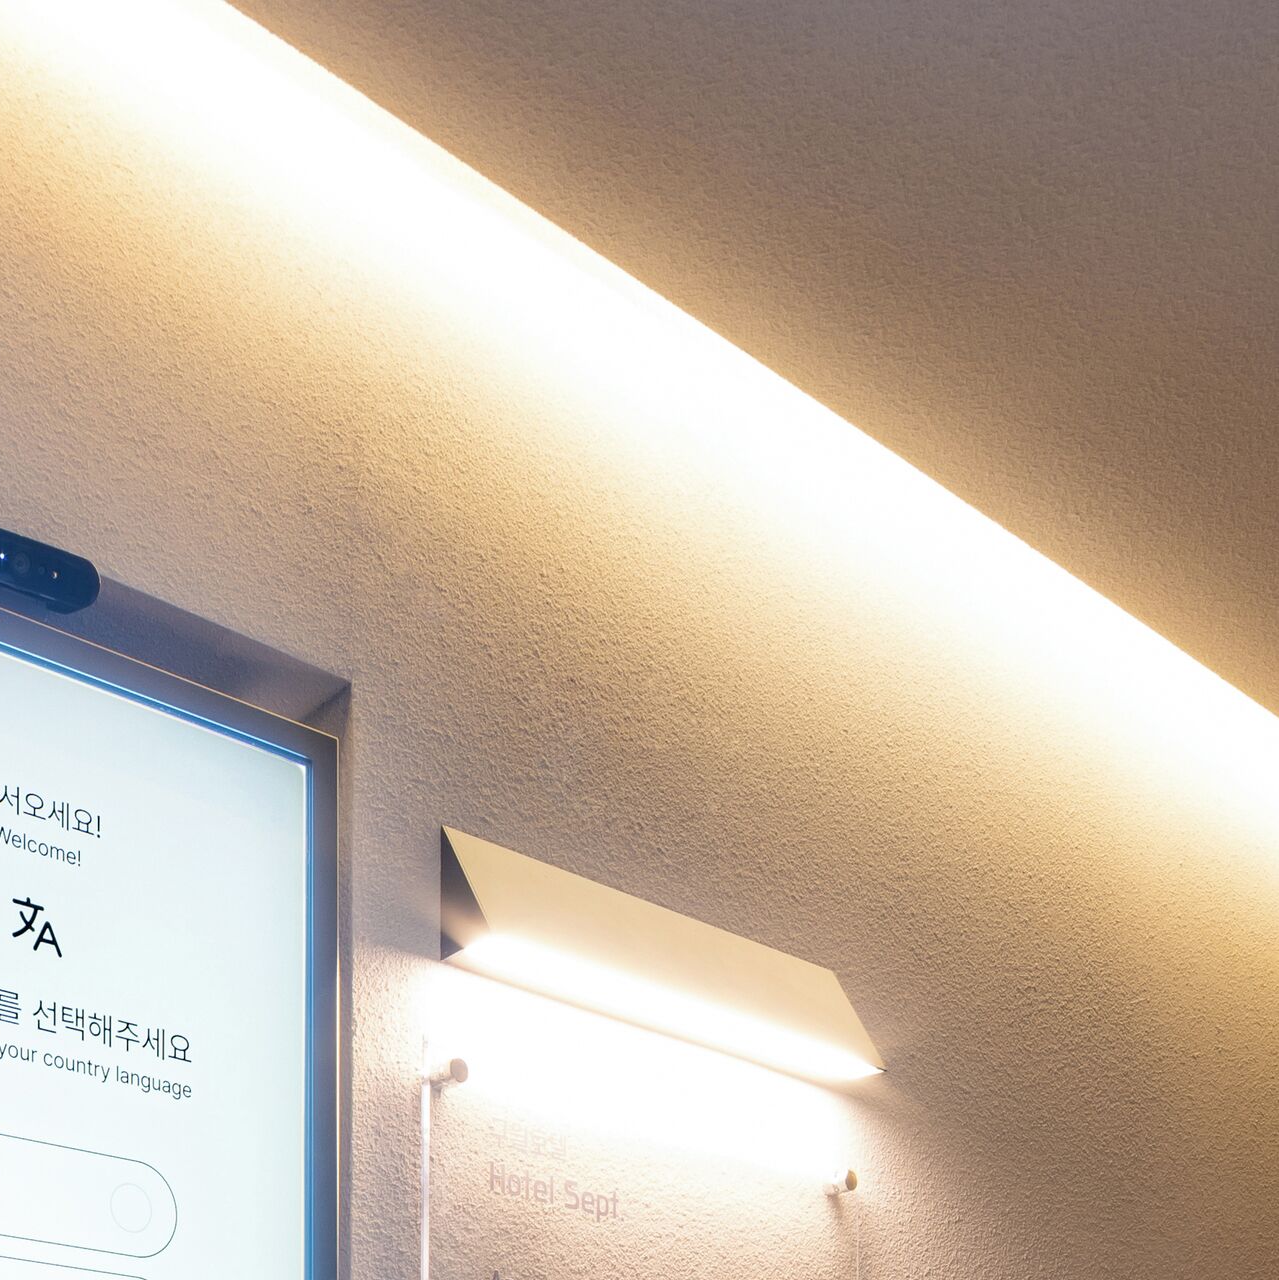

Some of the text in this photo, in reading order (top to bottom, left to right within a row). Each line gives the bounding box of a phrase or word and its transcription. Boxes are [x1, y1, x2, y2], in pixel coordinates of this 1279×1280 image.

[32, 1000, 192, 1063] 선택해주세요
[43, 1049, 110, 1082] country
[116, 1065, 192, 1100] language
[489, 1161, 554, 1204] Hotel
